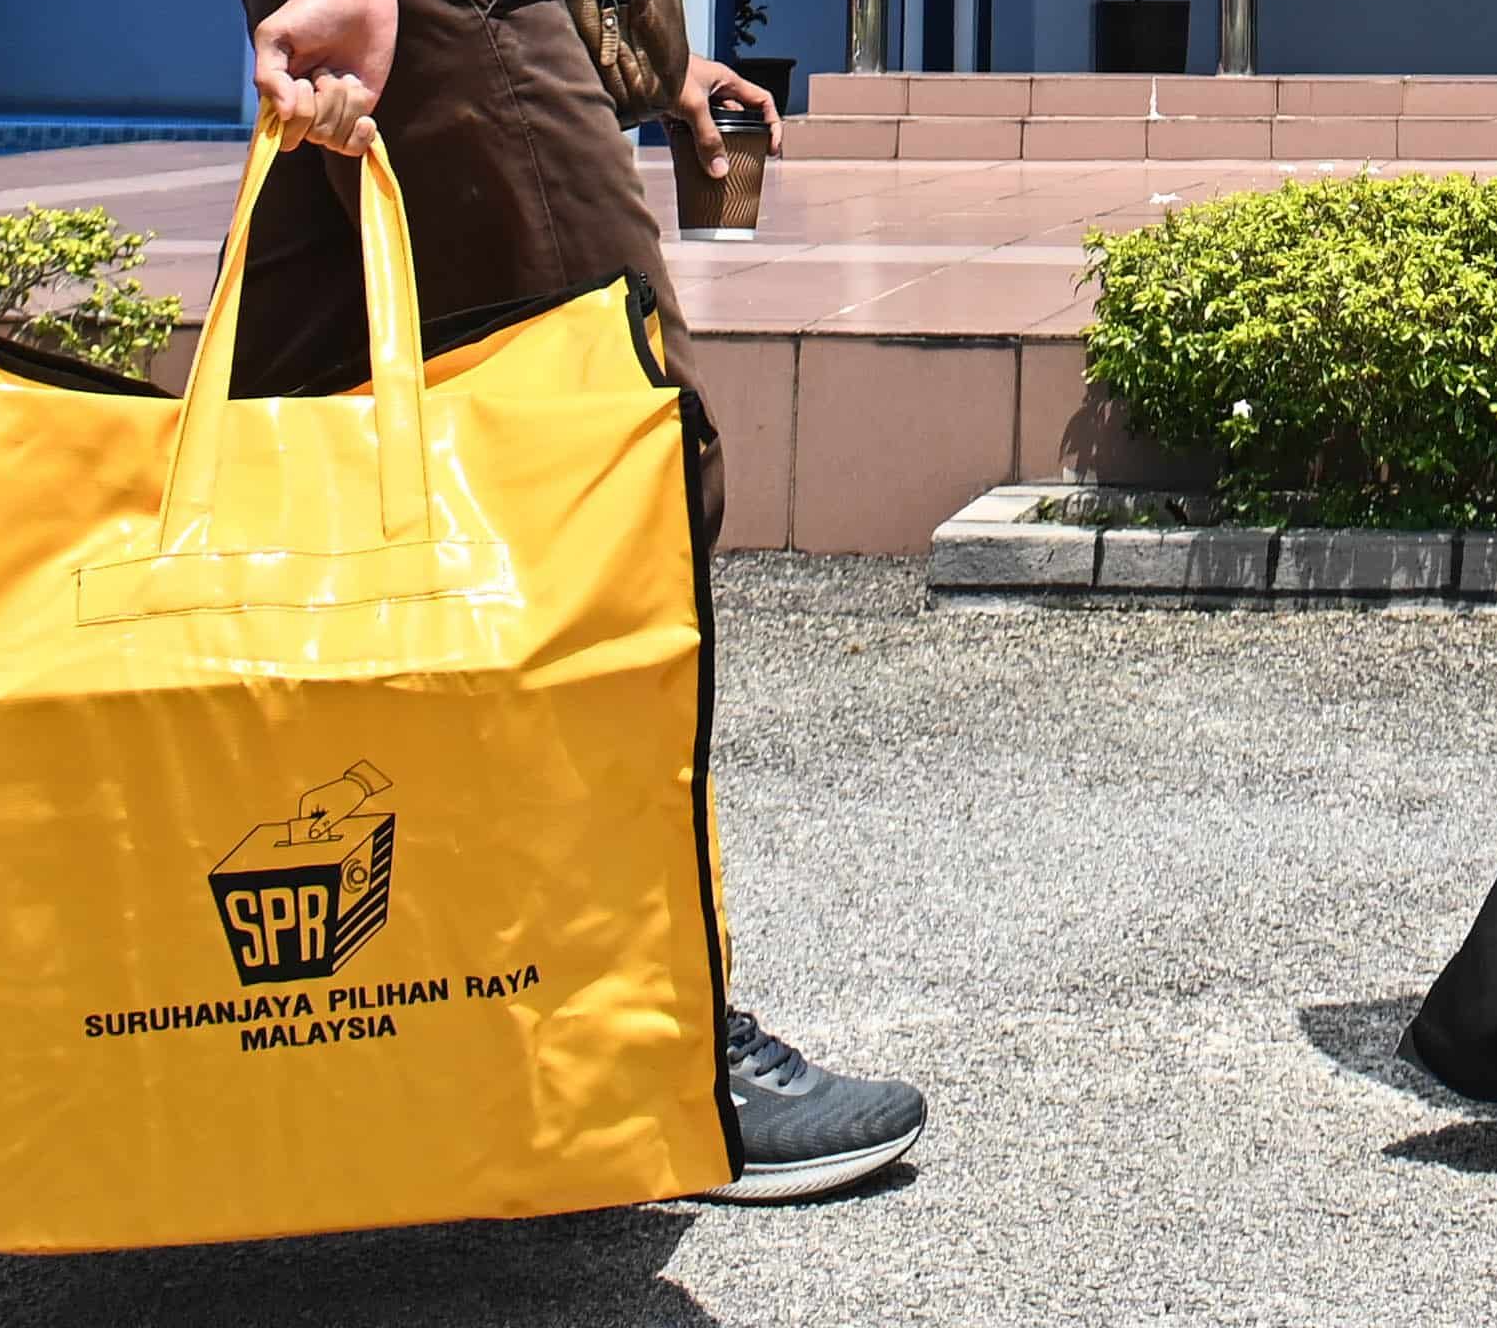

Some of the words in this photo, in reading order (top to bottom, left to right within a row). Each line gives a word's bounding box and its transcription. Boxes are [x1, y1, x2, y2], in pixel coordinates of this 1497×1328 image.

[224, 883, 330, 969] SPR
[84, 992, 314, 1039] SURUHANJAYA
[327, 977, 450, 1011] PILIHAN
[464, 964, 540, 1000] RAYA
[240, 1015, 398, 1052] MALAYSIA
